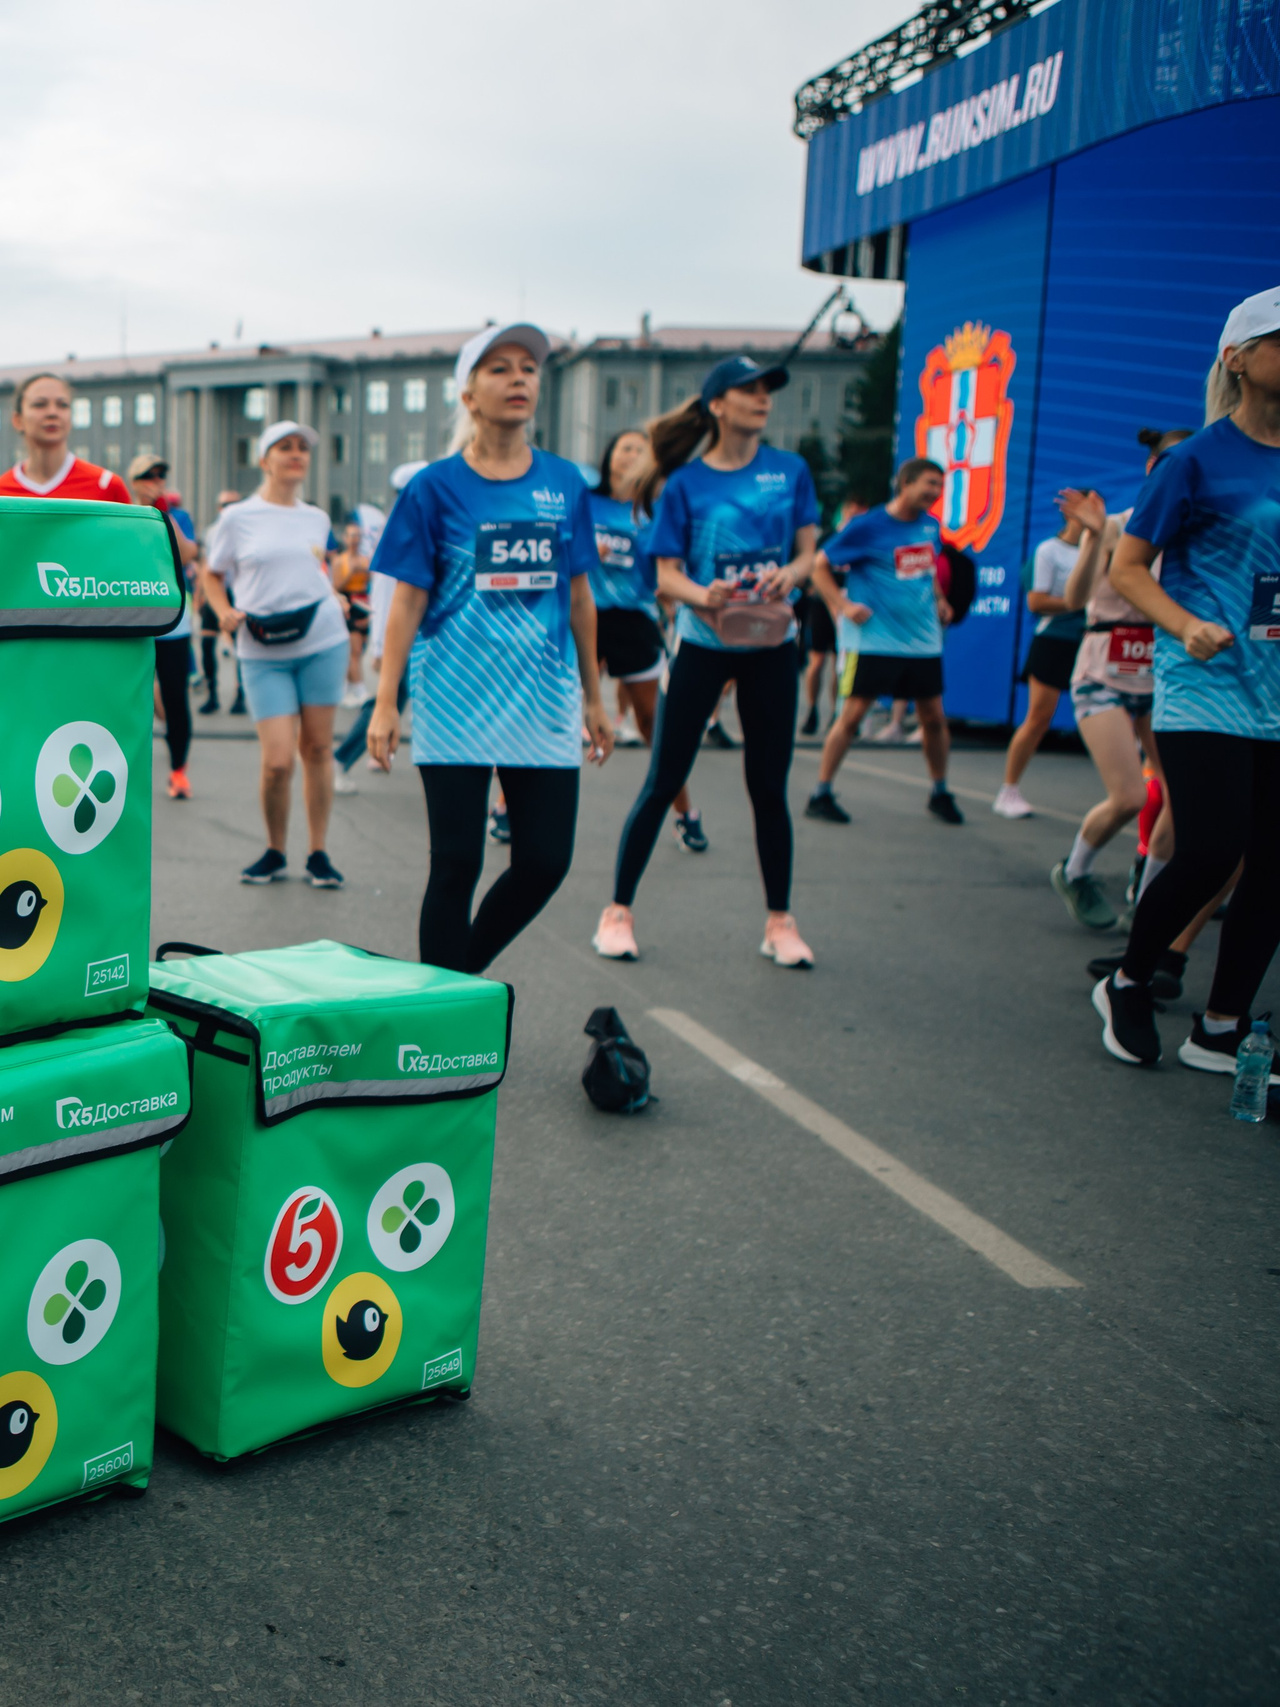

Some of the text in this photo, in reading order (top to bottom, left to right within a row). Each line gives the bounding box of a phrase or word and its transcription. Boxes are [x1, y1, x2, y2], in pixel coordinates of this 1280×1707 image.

[856, 51, 1064, 196] WWW.RUNSIM.RU
[491, 538, 552, 564] 5416
[92, 964, 125, 986] 25142
[263, 1043, 362, 1073] Доставляем
[263, 1063, 333, 1094] продукты
[427, 1357, 460, 1381] 25649
[88, 1452, 130, 1482] 25600
